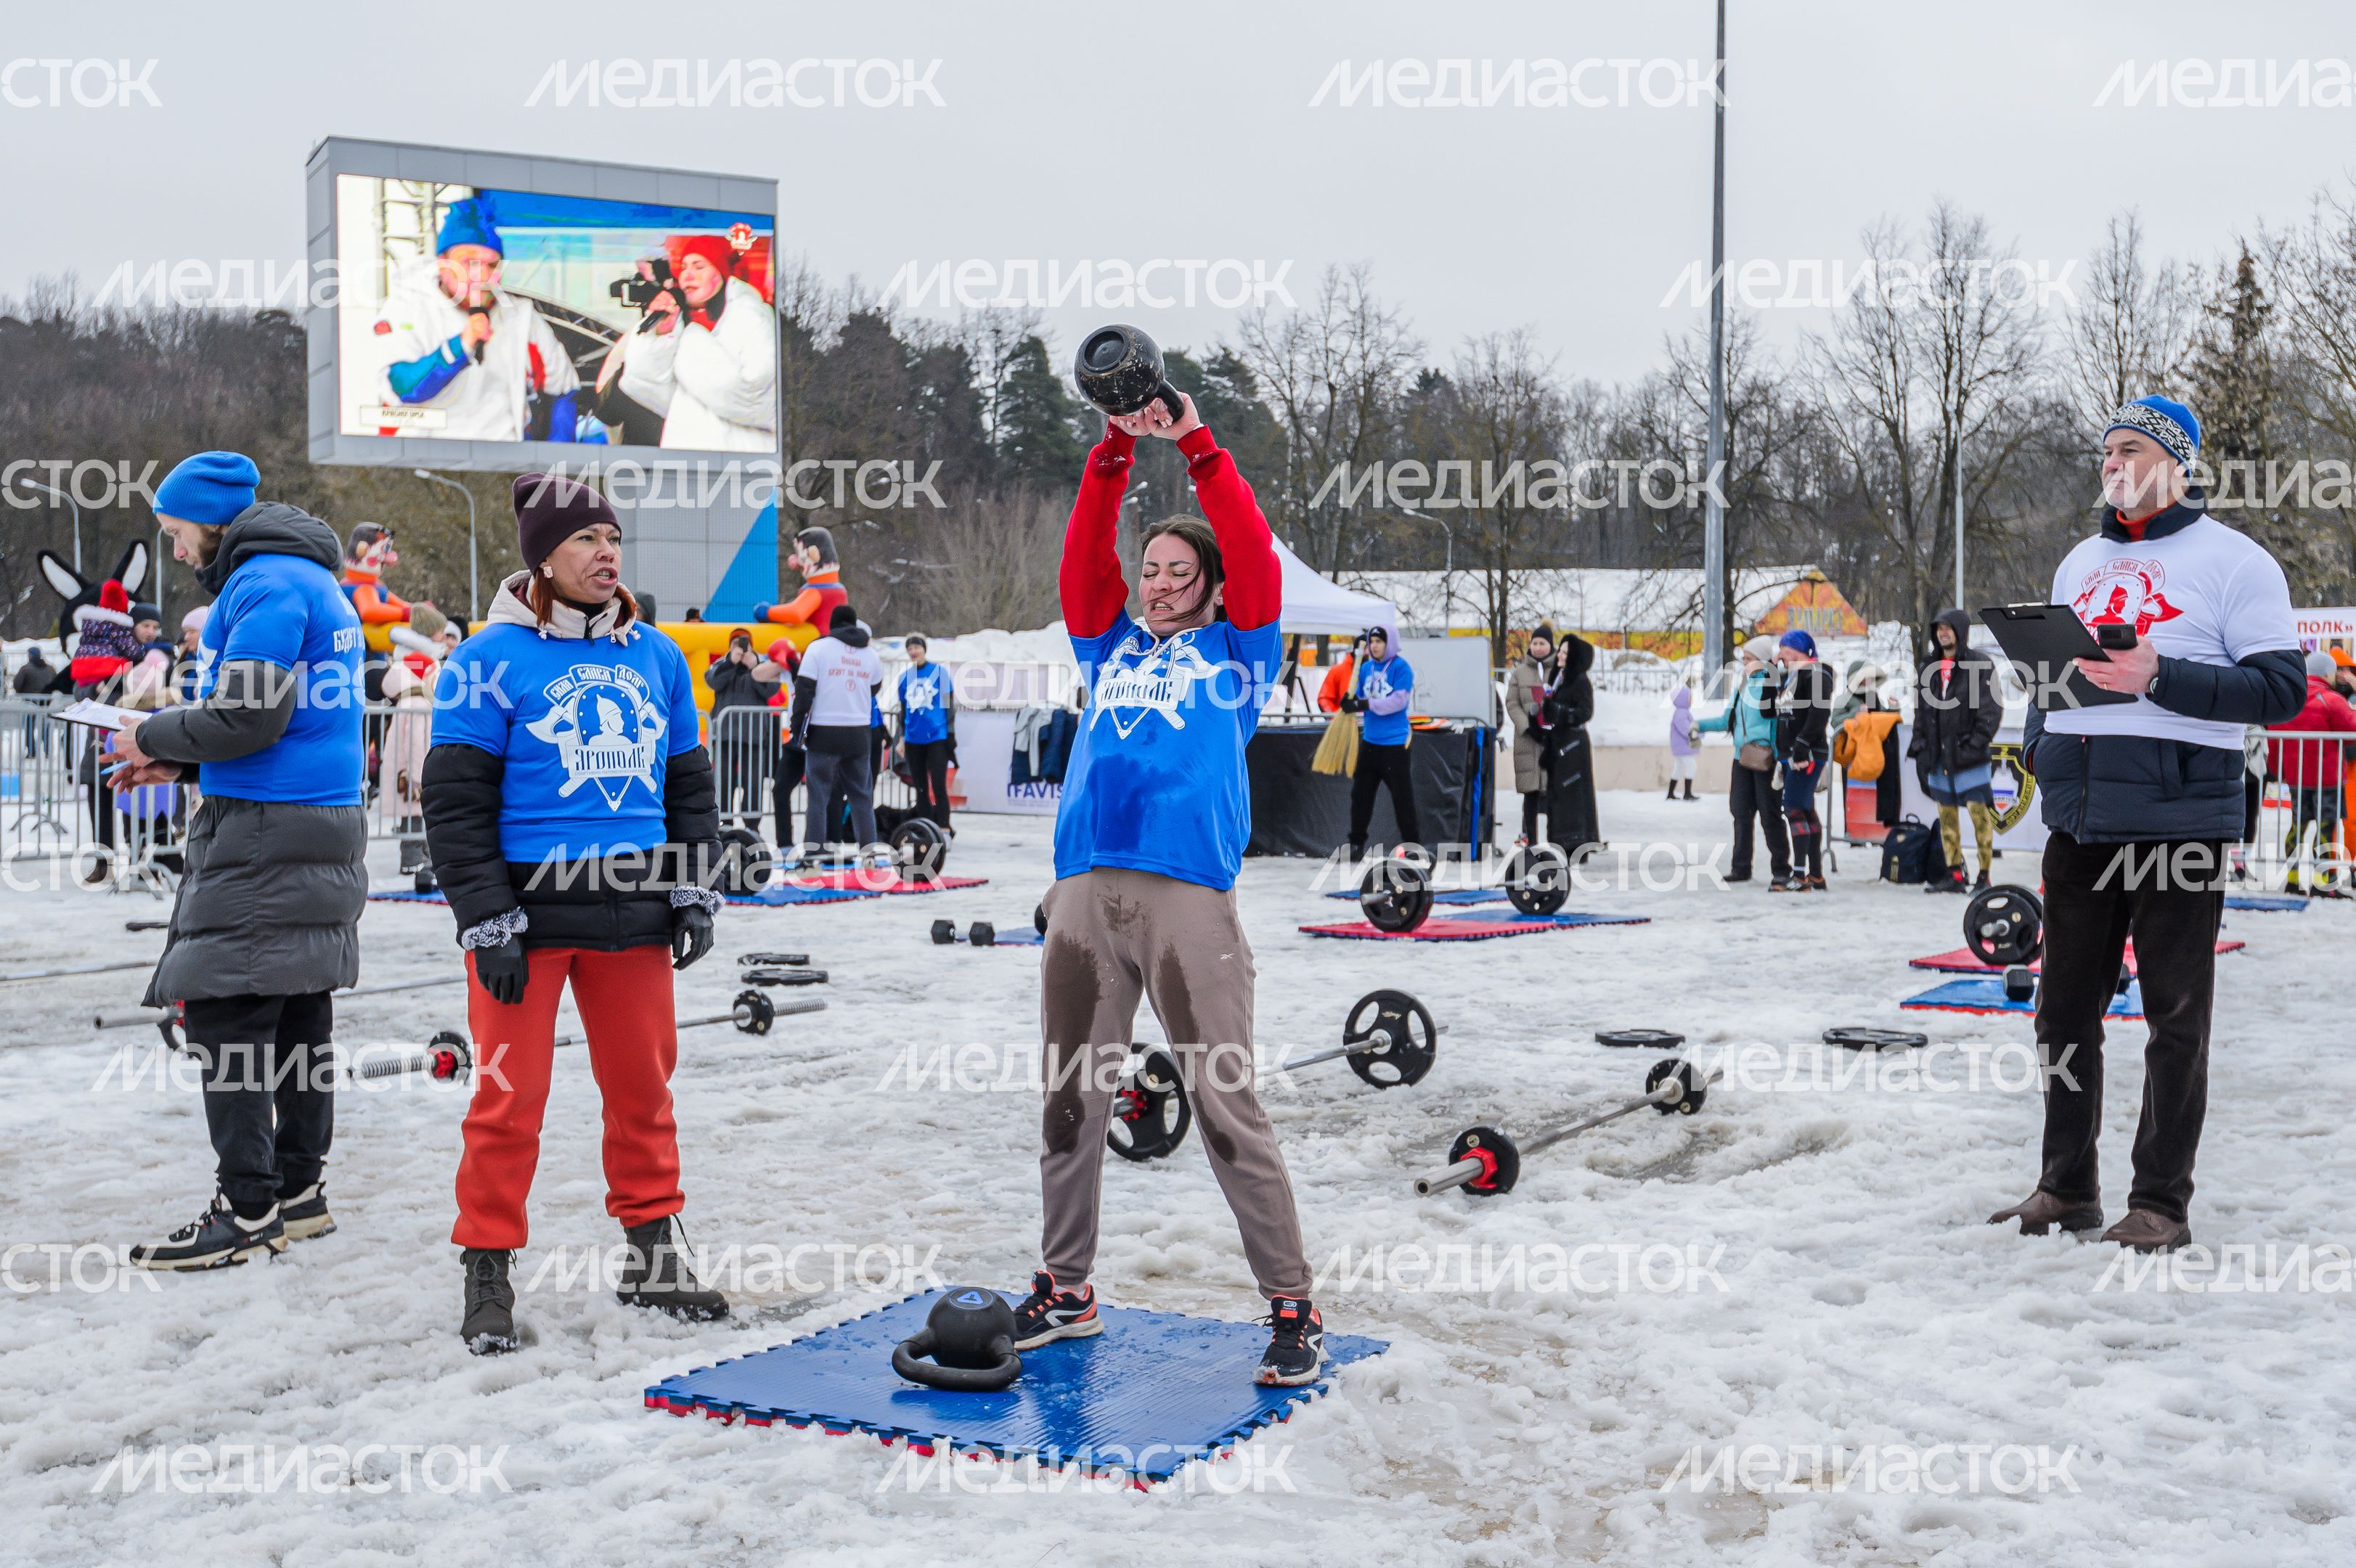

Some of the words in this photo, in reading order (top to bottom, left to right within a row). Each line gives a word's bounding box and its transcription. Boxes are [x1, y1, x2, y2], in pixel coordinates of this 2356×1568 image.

[577, 666, 612, 682] СЛАВА
[550, 679, 574, 701] СИЛА
[575, 746, 645, 771] ЯРОПОЛК
